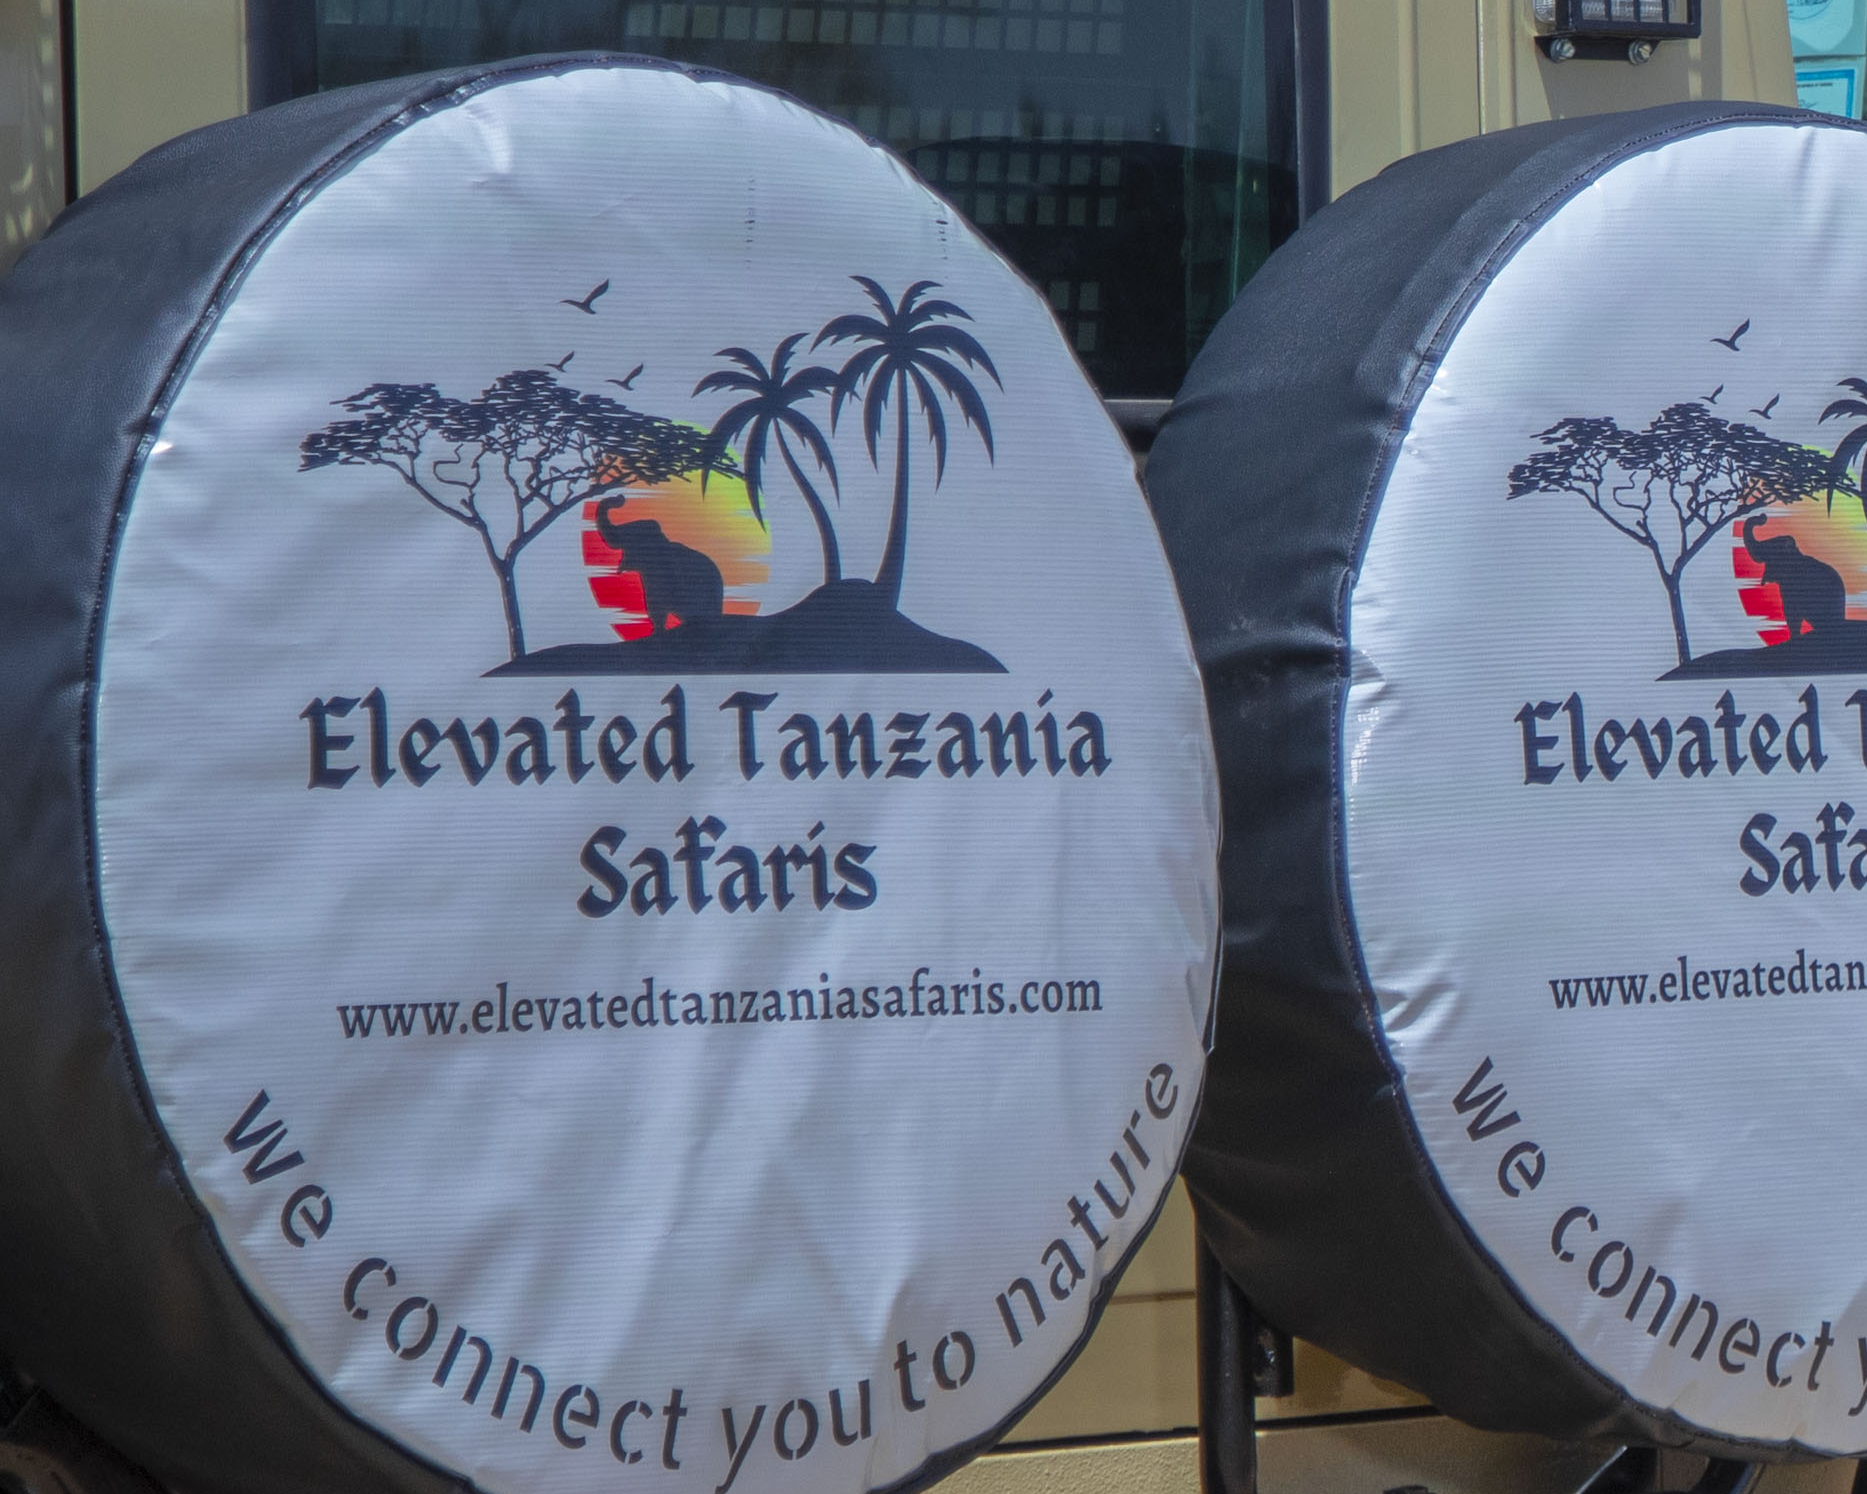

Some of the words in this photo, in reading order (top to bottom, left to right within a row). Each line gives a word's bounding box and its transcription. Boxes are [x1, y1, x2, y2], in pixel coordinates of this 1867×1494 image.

[300, 684, 694, 790] Elevated
[1514, 683, 1828, 786] Elevated
[337, 967, 1103, 1039] www.elevatedtanzaniasafaris.com
[223, 1088, 334, 1249] We
[342, 1256, 688, 1472] connect
[892, 1330, 977, 1414] to
[995, 1060, 1180, 1350] nature
[1452, 1056, 1547, 1199] We
[1550, 1205, 1835, 1392] connect
